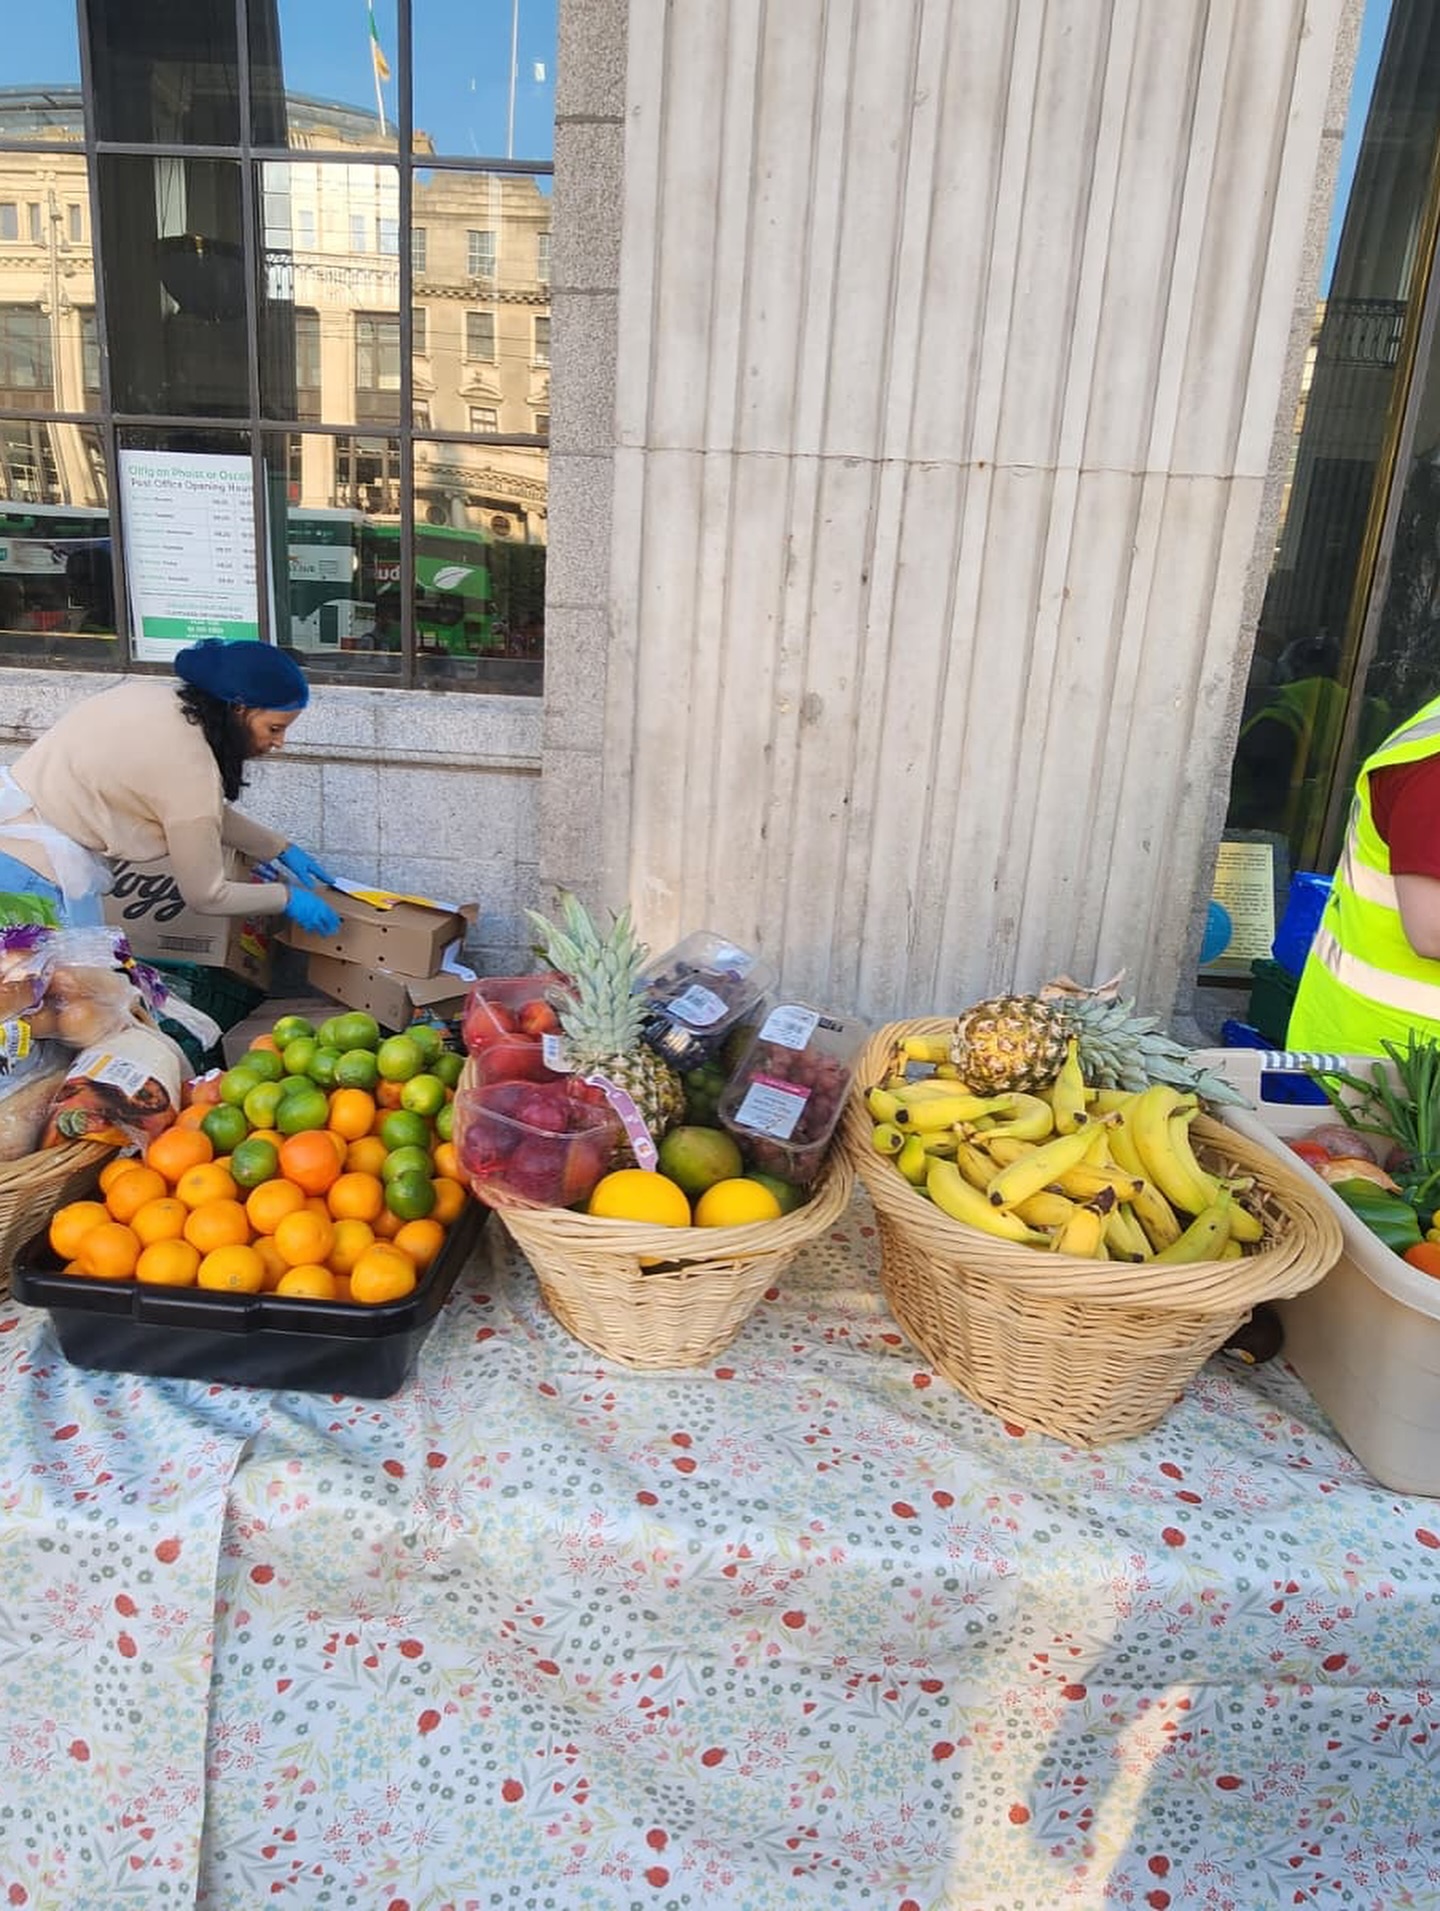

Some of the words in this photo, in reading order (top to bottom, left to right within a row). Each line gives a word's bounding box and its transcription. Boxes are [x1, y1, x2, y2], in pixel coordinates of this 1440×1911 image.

[132, 478, 151, 487] Post
[155, 479, 182, 488] Office
[185, 481, 225, 493] Opening
